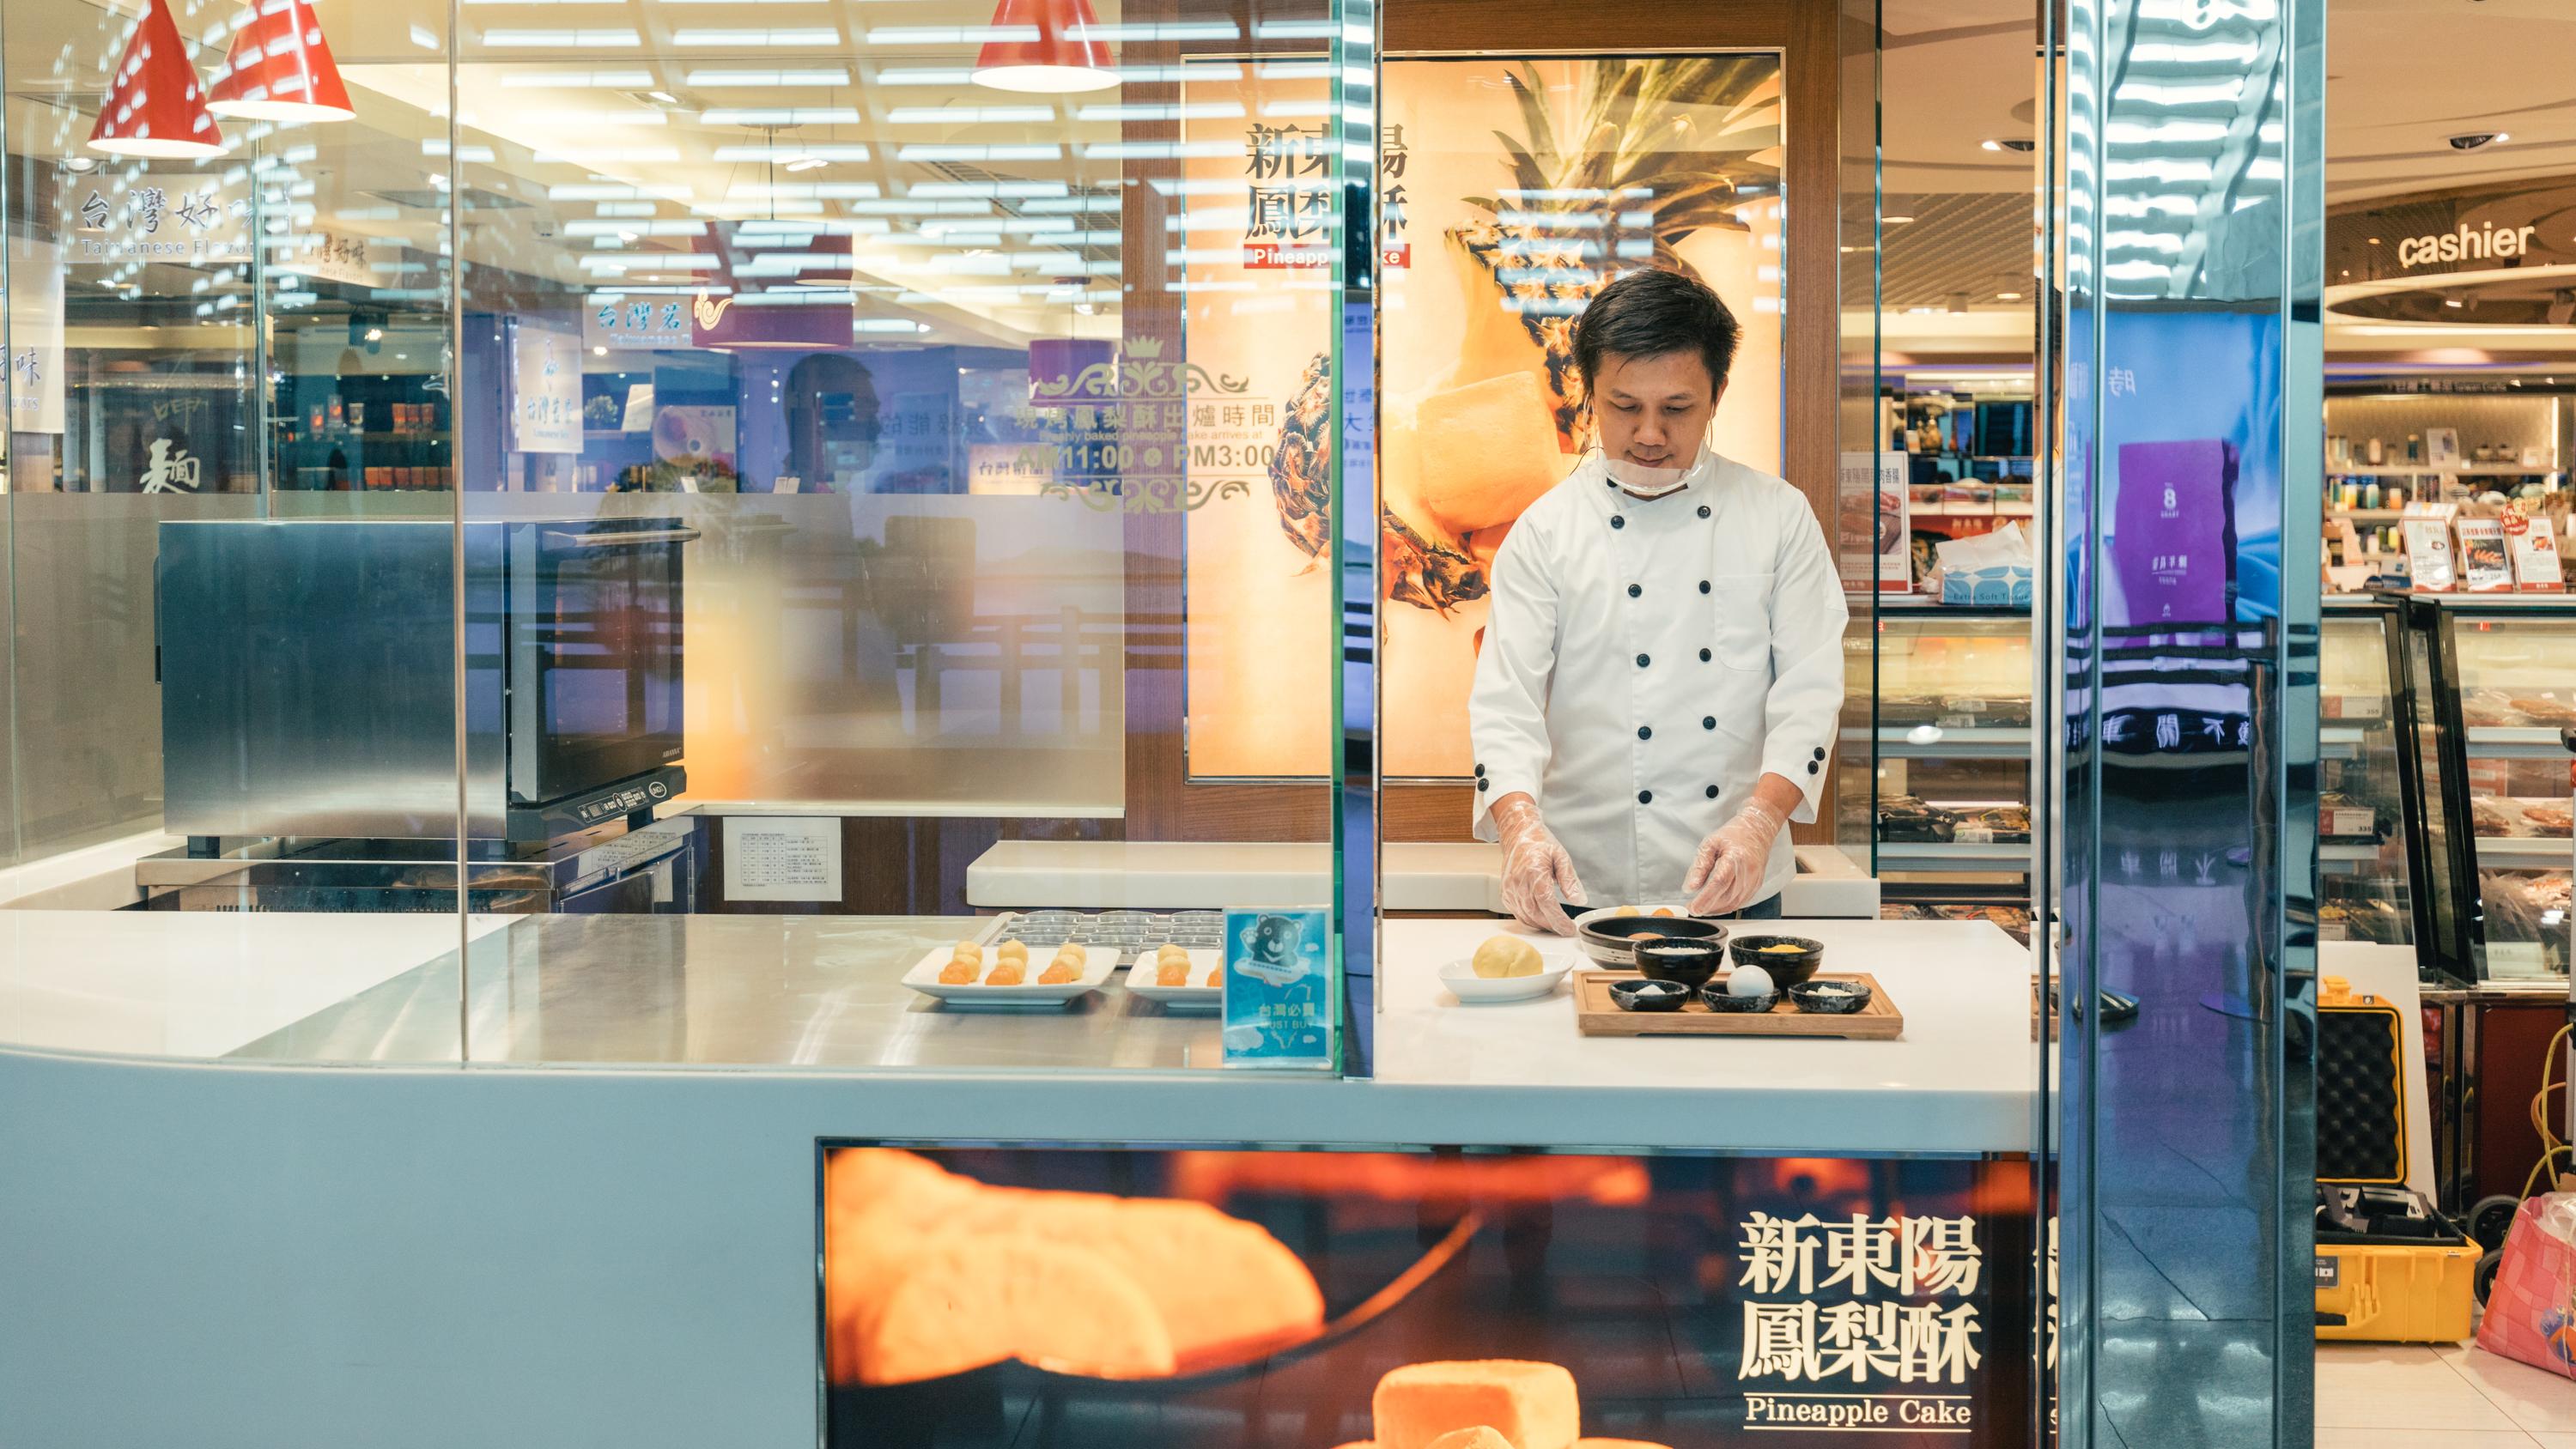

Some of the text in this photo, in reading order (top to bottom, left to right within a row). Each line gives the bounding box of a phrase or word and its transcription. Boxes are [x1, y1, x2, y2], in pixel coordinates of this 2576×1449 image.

[194, 239, 255, 255] Flvo
[2398, 221, 2535, 268] cashier
[1254, 248, 1329, 267] Pineapp
[598, 302, 692, 330] 台灣茗
[1016, 404, 1275, 428] 現烤鳳梨酥出爐時間
[1084, 430, 1118, 441] baked
[1212, 430, 1249, 441] arrives
[1253, 430, 1264, 440] at
[1173, 445, 1276, 468] PM3:00
[1979, 592, 1997, 601] Soft
[2002, 592, 2029, 601] Tissue
[1739, 1211, 1982, 1295] 新東陽
[1738, 1300, 1982, 1384] 鳳梨酥
[1746, 1397, 1971, 1427] Pineapple Cake
